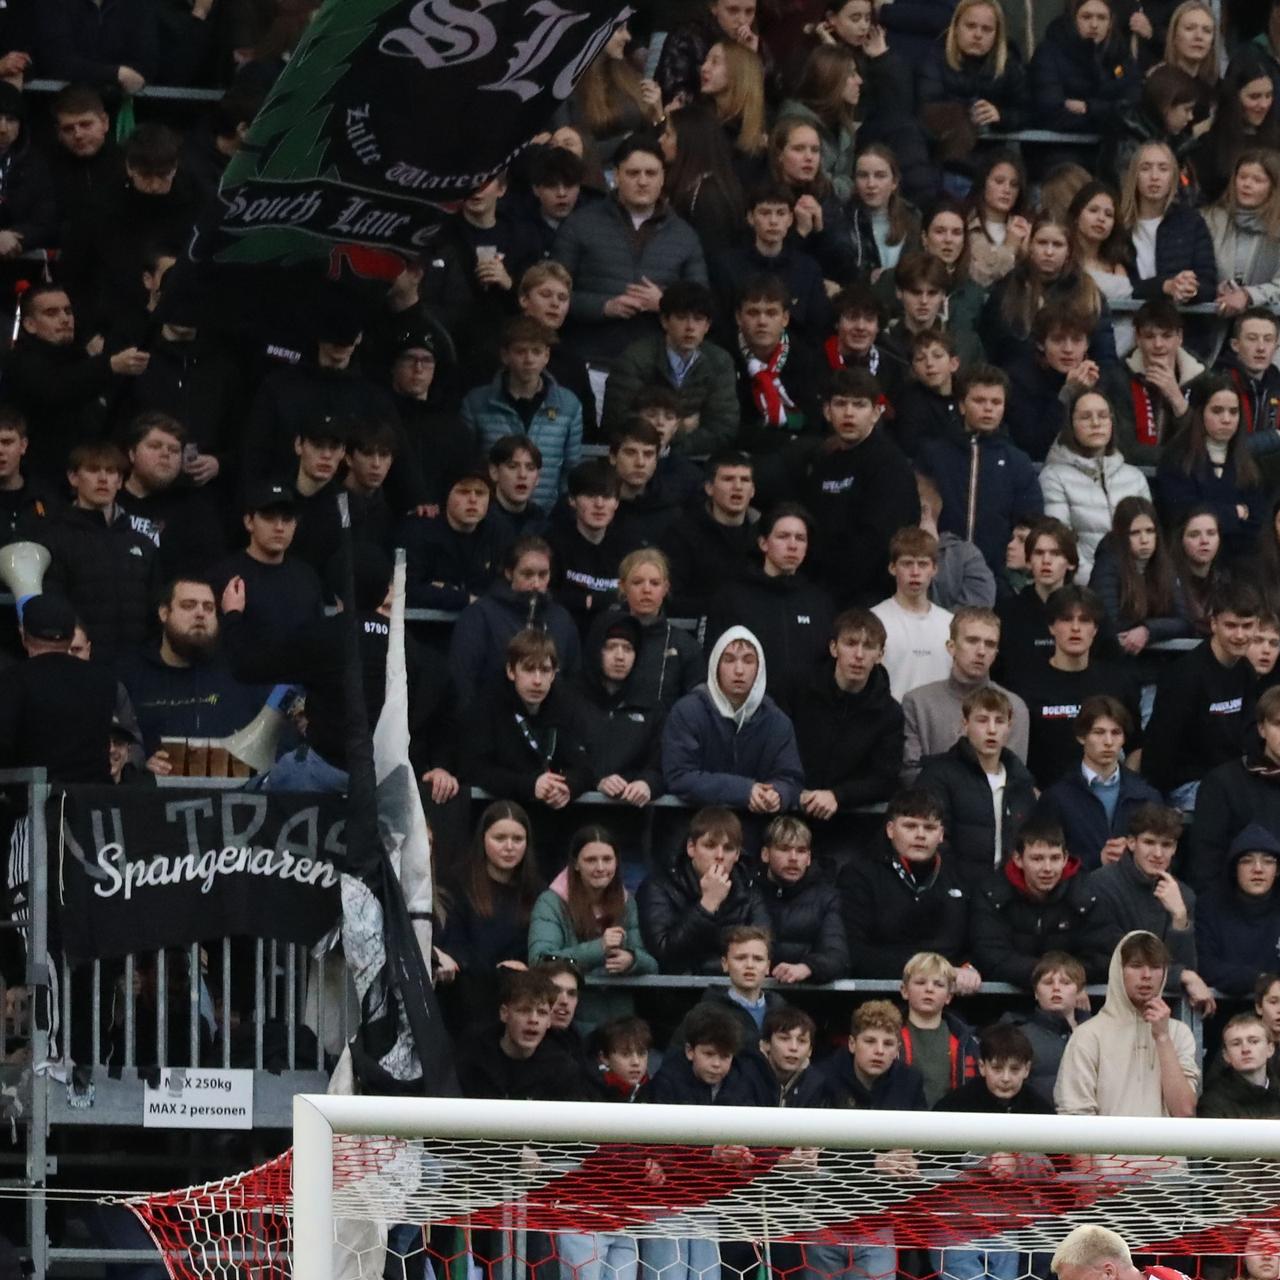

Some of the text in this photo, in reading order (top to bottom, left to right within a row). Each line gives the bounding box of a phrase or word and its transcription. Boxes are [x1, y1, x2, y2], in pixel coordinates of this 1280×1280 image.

[222, 188, 320, 223] South
[328, 195, 411, 238] Lane
[94, 843, 342, 900] Spangenaren
[165, 1078, 232, 1093] MX 250kg
[149, 1103, 246, 1118] MAX 2 personen
